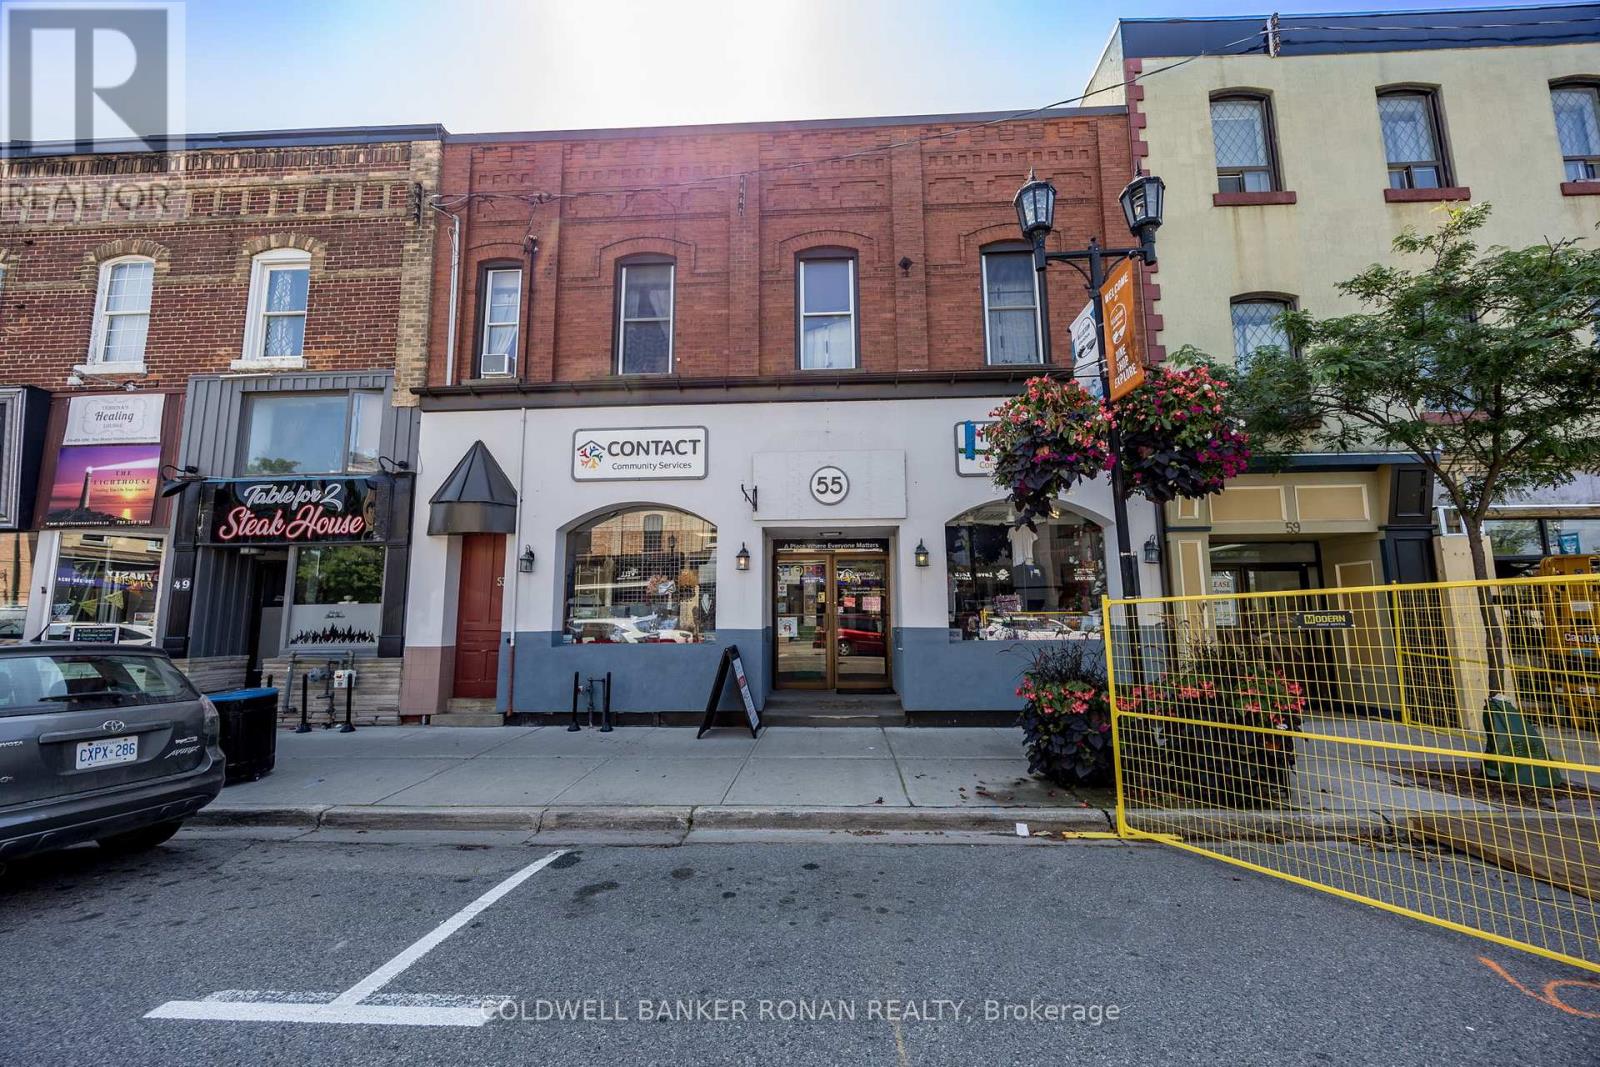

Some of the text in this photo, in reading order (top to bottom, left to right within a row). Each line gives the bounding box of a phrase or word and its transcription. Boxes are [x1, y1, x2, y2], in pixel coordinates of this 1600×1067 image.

[1104, 271, 1129, 304] WELCOME
[1114, 362, 1137, 389] EXPLORE
[95, 411, 135, 423] Healing
[607, 439, 701, 456] CONTACT
[612, 461, 692, 471] Community Services
[816, 476, 843, 495] 55
[244, 483, 343, 512] Table for 2
[219, 504, 364, 540] Steak House
[1285, 522, 1301, 535] 59
[827, 542, 855, 550] Everyone
[173, 580, 190, 590] 49
[1304, 614, 1346, 625] MODERN
